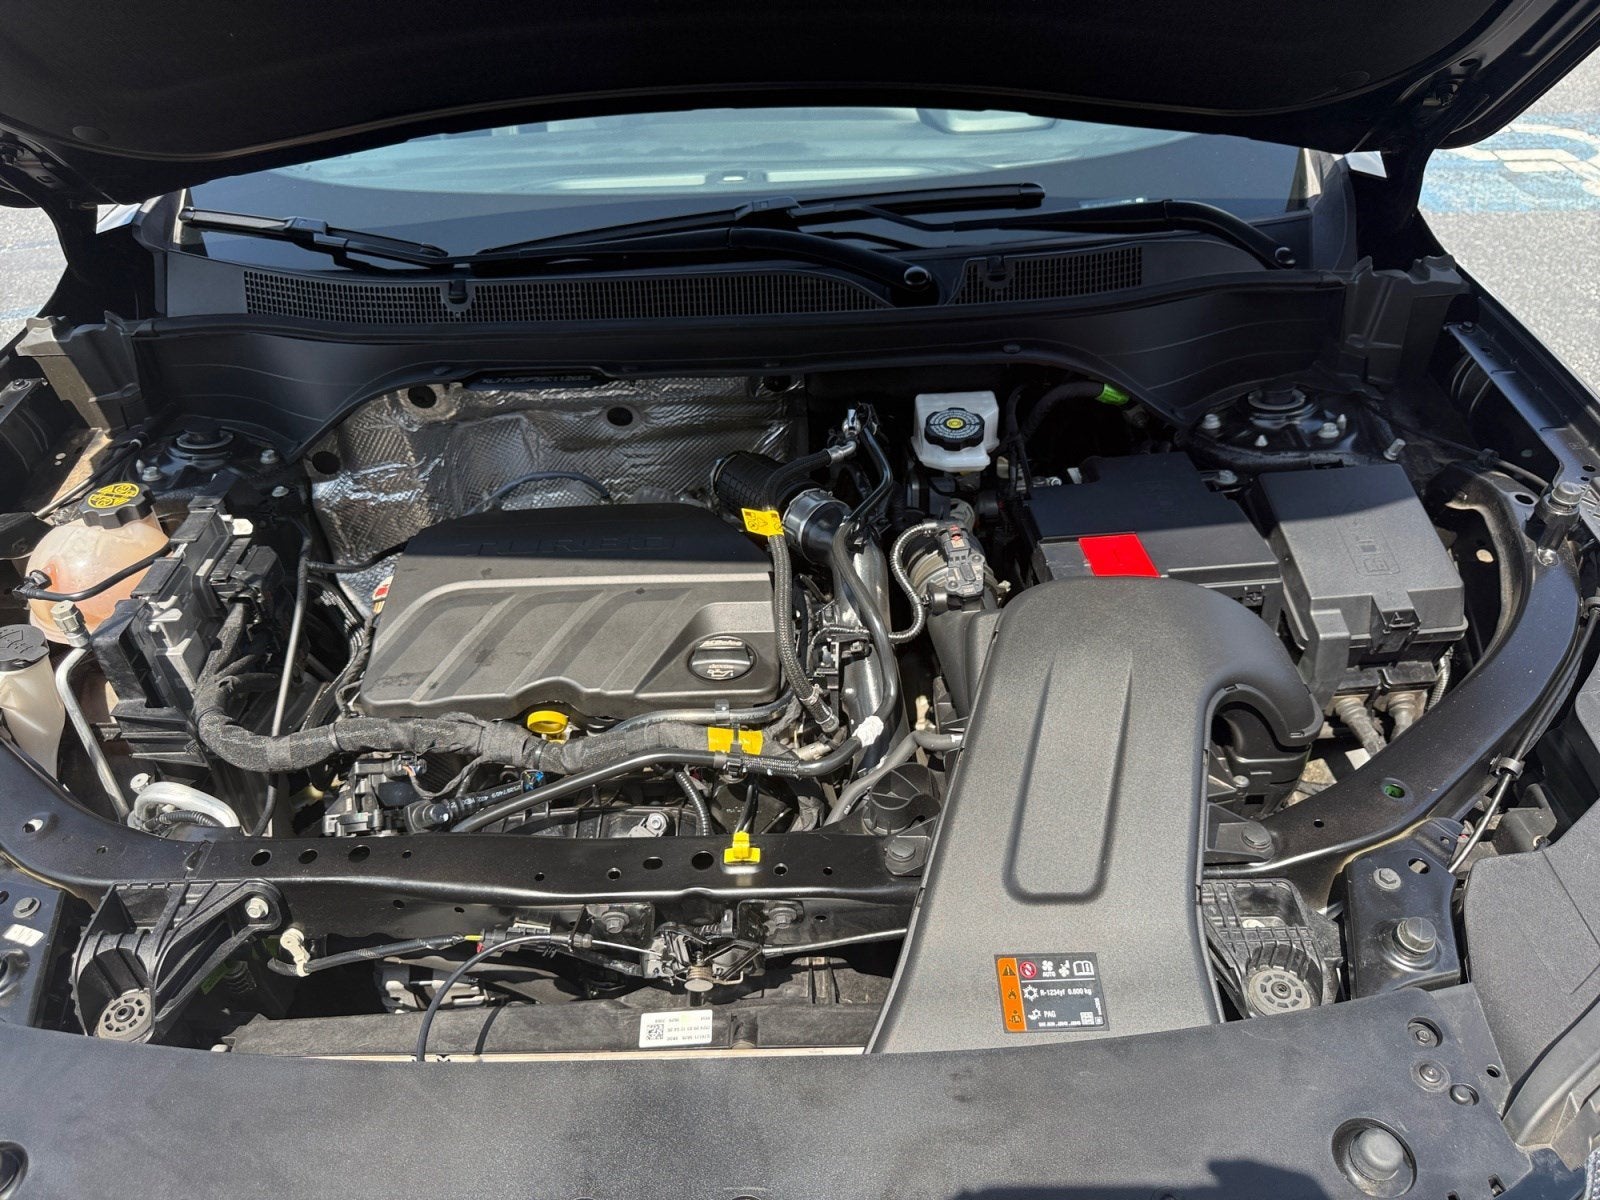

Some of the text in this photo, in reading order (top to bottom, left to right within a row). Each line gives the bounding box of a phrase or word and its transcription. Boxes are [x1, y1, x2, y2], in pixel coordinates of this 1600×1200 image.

[1039, 988, 1066, 997] R-1234yf
[1084, 987, 1092, 996] kg
[1043, 1010, 1056, 1018] PAG
